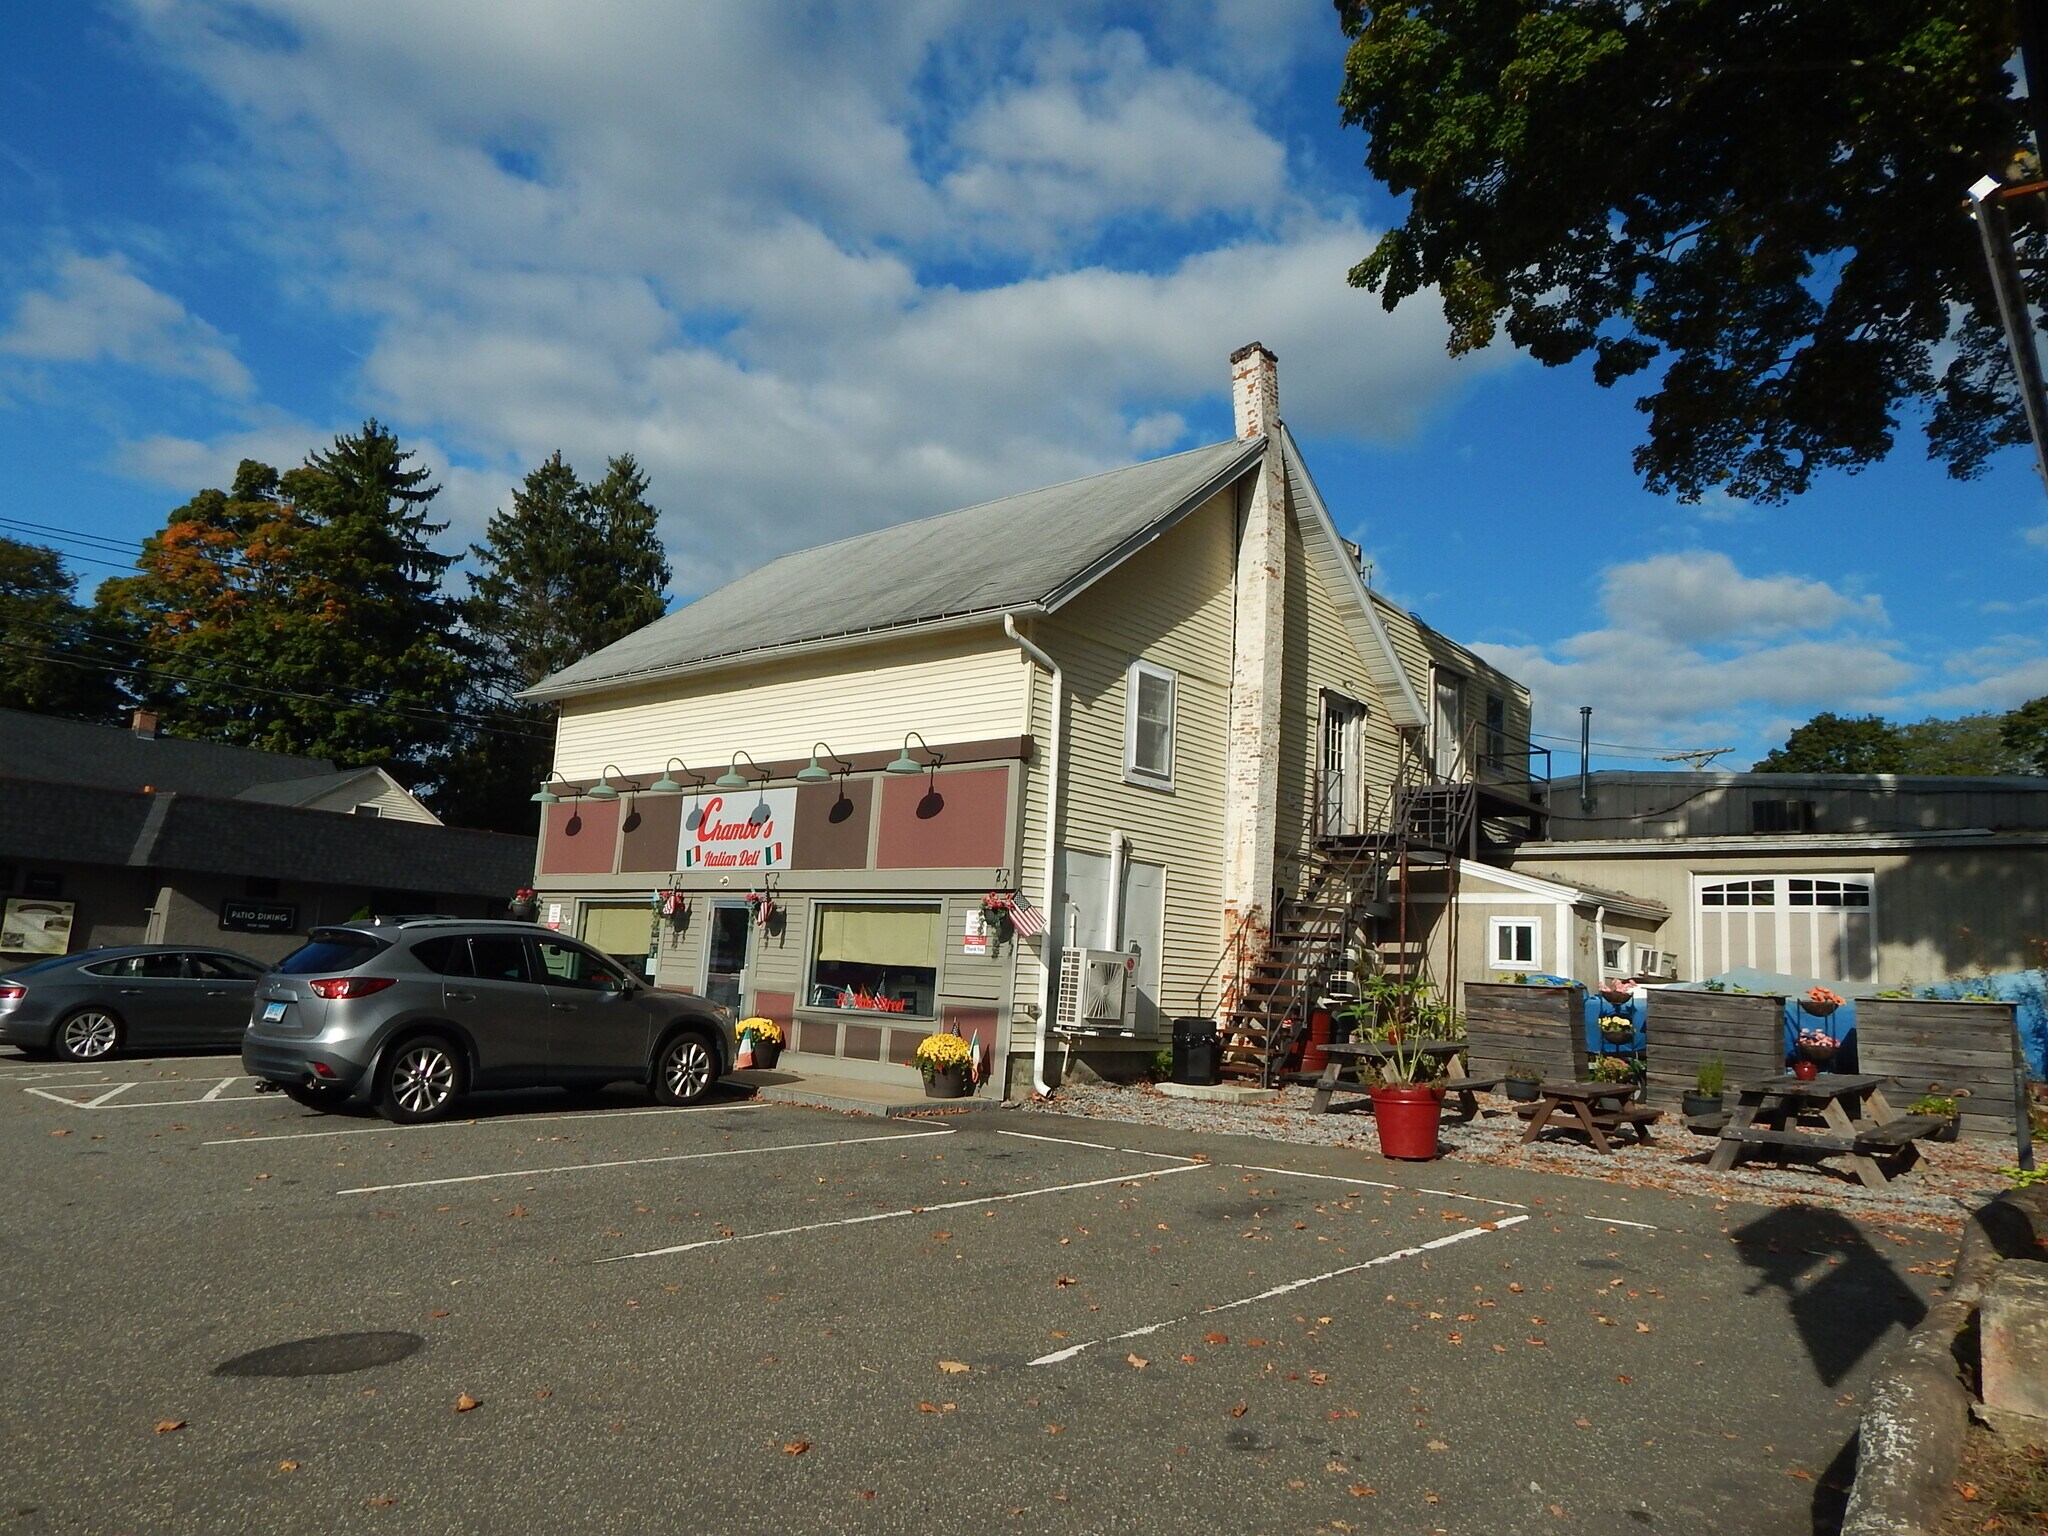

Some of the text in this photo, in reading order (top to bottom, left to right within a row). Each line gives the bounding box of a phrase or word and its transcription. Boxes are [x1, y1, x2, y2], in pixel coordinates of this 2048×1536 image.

[697, 797, 774, 842] Chambo's
[703, 849, 761, 867] Italian Deli
[231, 910, 288, 921] PATIO DINING
[879, 995, 905, 1012] Street
